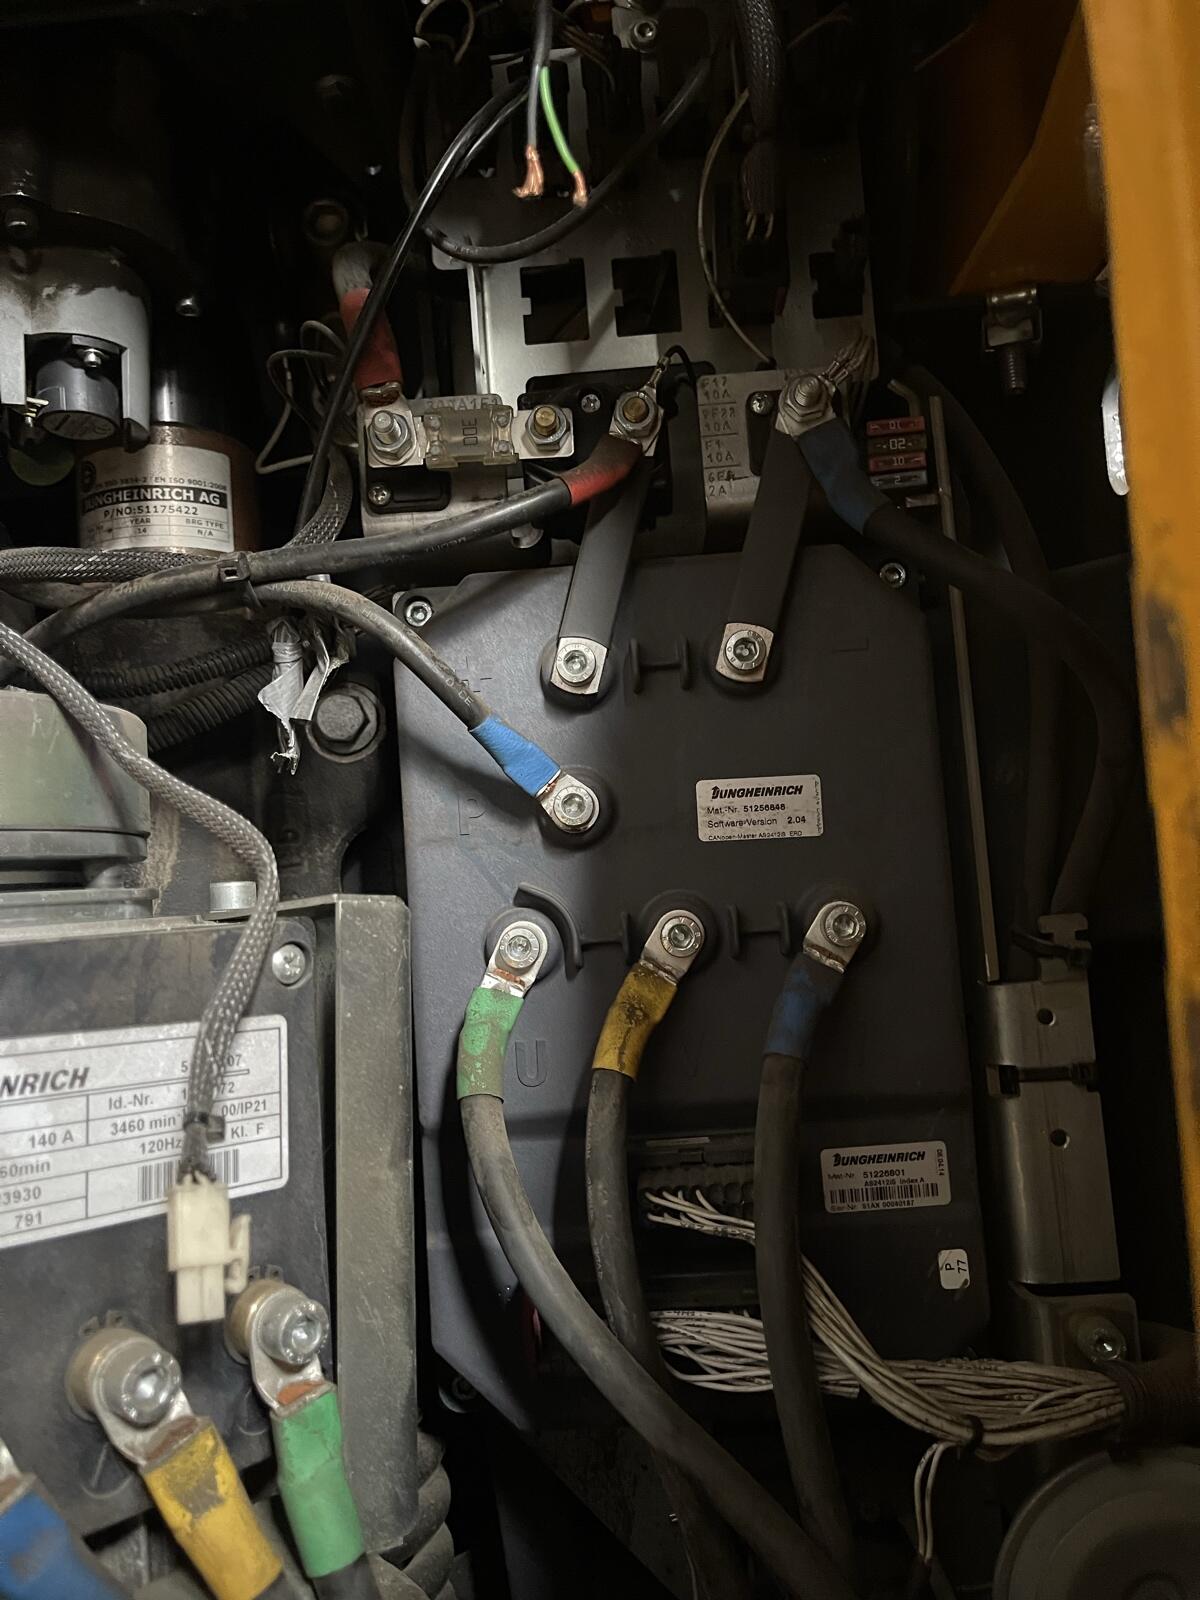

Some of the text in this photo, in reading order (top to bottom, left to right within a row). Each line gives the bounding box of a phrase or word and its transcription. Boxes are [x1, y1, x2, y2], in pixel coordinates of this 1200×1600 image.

[199, 491, 221, 505] AG
[205, 520, 225, 529] TYPE
[711, 785, 803, 799] JUNGHEINRICH
[787, 815, 807, 824] 2.04
[0, 1067, 91, 1097] NRICH
[108, 1094, 154, 1111] Id.-Nr.
[111, 1119, 145, 1136] 3460
[256, 1122, 265, 1135] F
[29, 1130, 74, 1148] 140 A
[140, 1138, 183, 1155] 120Hz
[832, 1151, 926, 1167] JUNGHEINRICH
[15, 1211, 42, 1230] 791
[945, 1262, 955, 1271] P
[956, 1259, 968, 1275] 77
